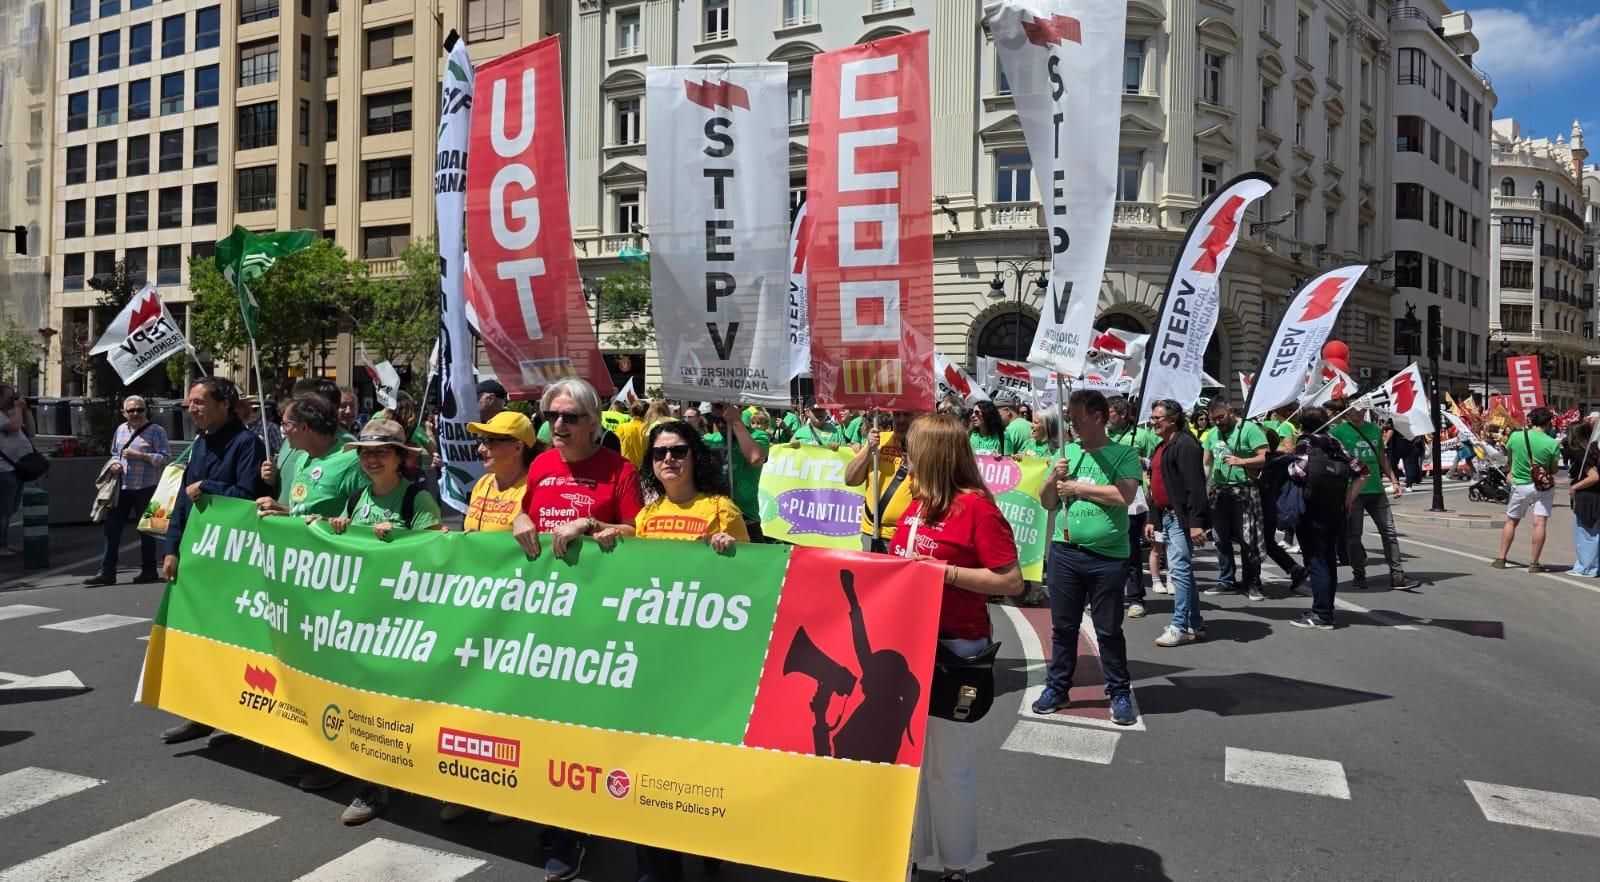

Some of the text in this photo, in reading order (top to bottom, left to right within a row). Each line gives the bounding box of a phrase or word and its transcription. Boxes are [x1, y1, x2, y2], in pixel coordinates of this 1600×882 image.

[490, 67, 546, 340] UGT
[838, 53, 901, 342] CCOO
[702, 117, 739, 360] STEPV
[1160, 278, 1196, 370] STEPV
[1182, 286, 1211, 373] INTERSINDICAL
[1269, 327, 1306, 378] STEPV
[680, 366, 769, 380] INTERSINDICAL
[696, 377, 769, 391] VALENCIANA
[539, 506, 575, 517] Salvem
[647, 519, 686, 530] CCOO
[192, 523, 221, 558] JA
[281, 547, 363, 594] PROU!
[380, 561, 578, 617] -burocràcia
[602, 577, 752, 631] -ràtios
[300, 609, 438, 663] +plantilla
[454, 632, 639, 689] +valencià
[239, 690, 278, 714] STEPV
[325, 714, 345, 733] CSIF
[348, 709, 414, 735] Central Sindical
[349, 724, 412, 754] Independiente y
[442, 733, 494, 758] CCOO
[350, 741, 414, 768] de Funcionarios
[438, 760, 518, 789] educació
[548, 759, 603, 794] UGT
[641, 774, 725, 800] Ensenyament
[639, 795, 727, 818] Serveis Públics PV
